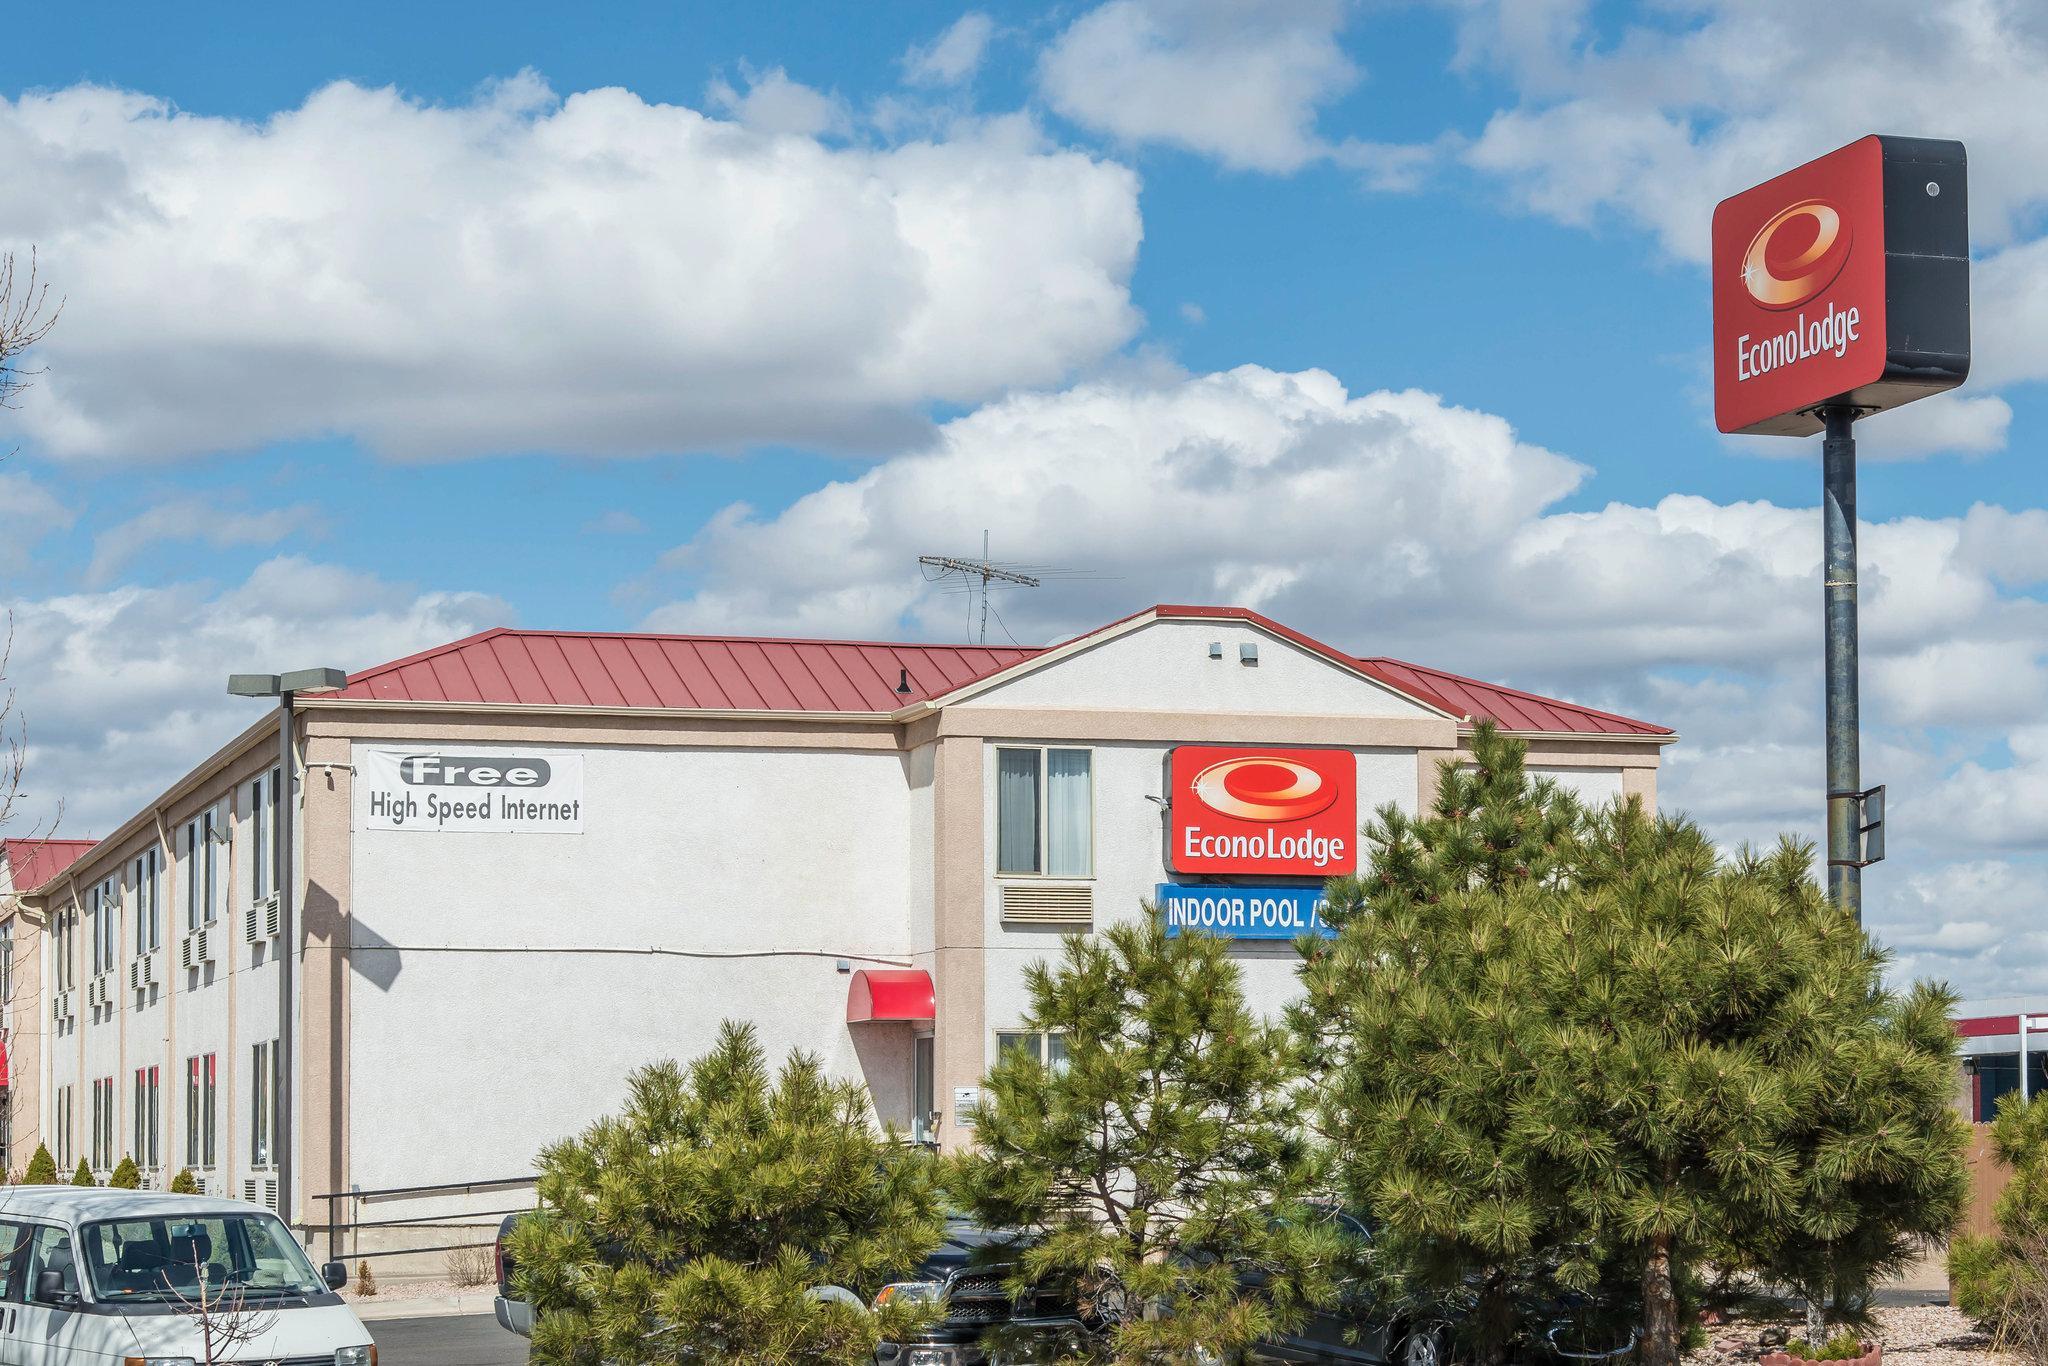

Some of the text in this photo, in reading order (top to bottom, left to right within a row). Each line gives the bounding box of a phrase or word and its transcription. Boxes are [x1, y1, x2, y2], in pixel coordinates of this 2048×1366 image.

[1738, 302, 1860, 382] EconoLodge
[412, 757, 539, 786] Free
[370, 791, 579, 825] High Speed Internet
[1185, 826, 1345, 867] EconoLodge
[1168, 897, 1245, 927] INDOOR
[1250, 898, 1304, 927] POOL
